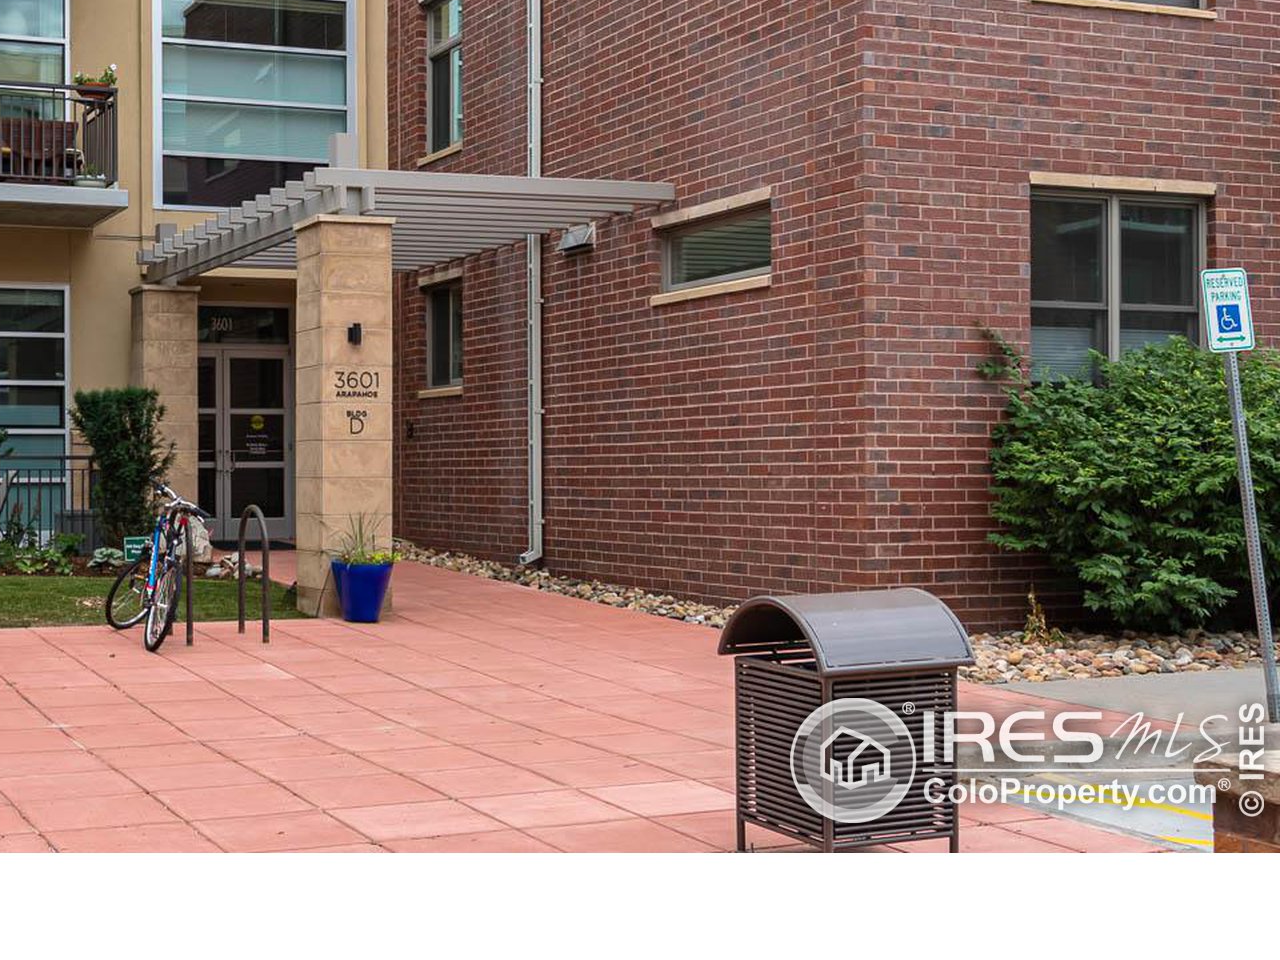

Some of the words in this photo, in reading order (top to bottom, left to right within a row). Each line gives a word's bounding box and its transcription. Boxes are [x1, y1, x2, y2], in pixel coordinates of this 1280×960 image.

[1206, 277, 1243, 289] RESERVED
[1211, 291, 1242, 302] PARKING
[211, 317, 233, 331] 3601
[334, 371, 380, 389] 3601
[346, 410, 367, 418] BLDG
[349, 418, 364, 435] D
